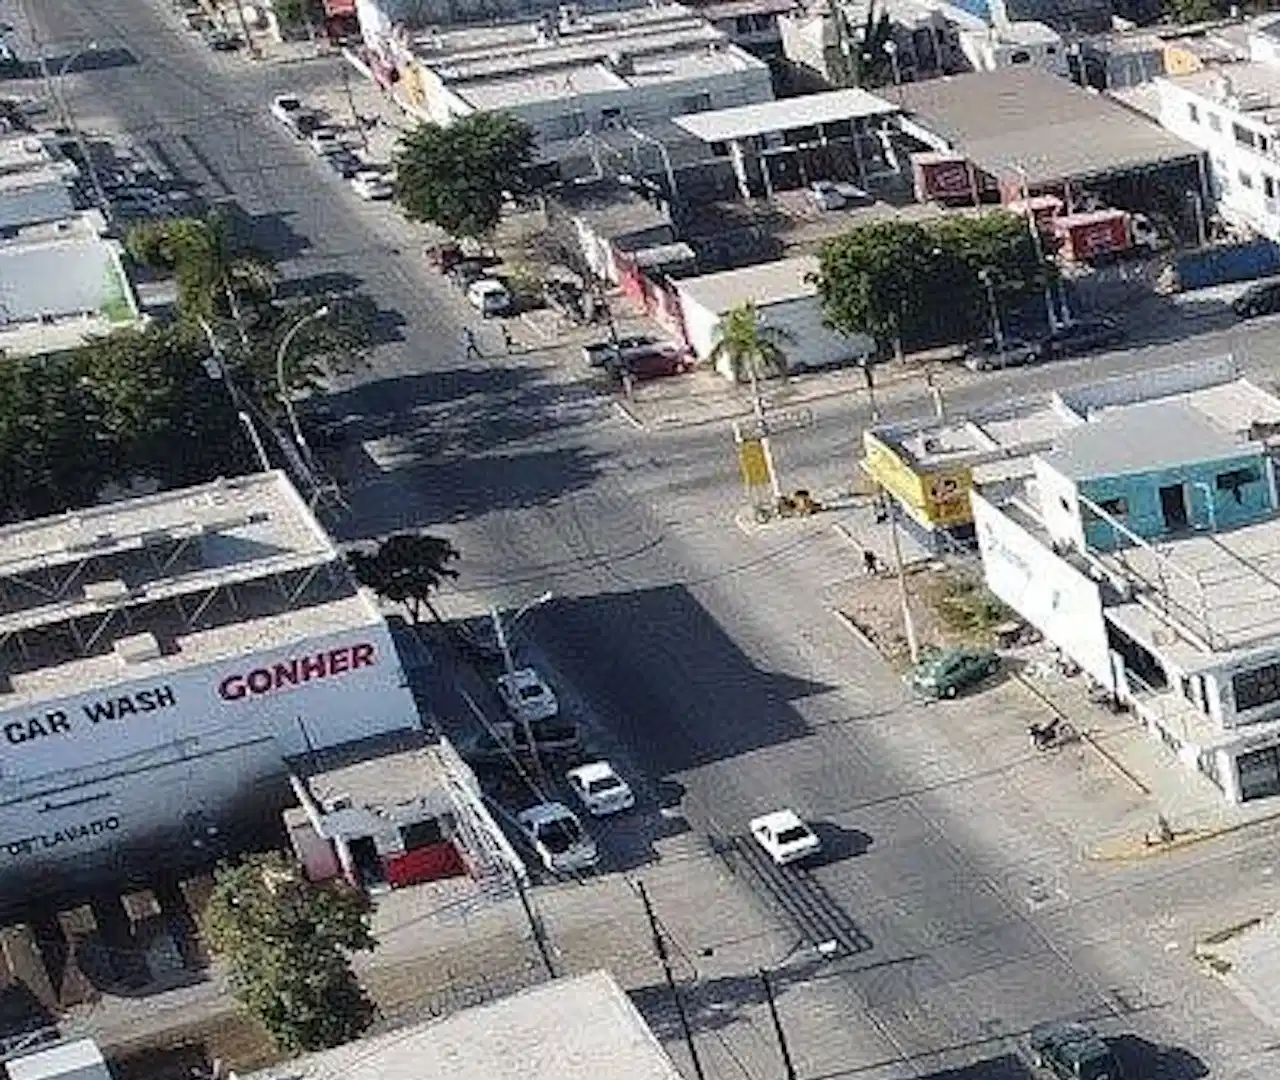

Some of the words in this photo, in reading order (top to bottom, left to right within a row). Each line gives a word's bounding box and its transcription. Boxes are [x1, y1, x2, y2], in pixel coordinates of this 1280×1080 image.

[218, 642, 377, 702] GONHER
[2, 709, 72, 746] CAR
[83, 684, 178, 725] WASH
